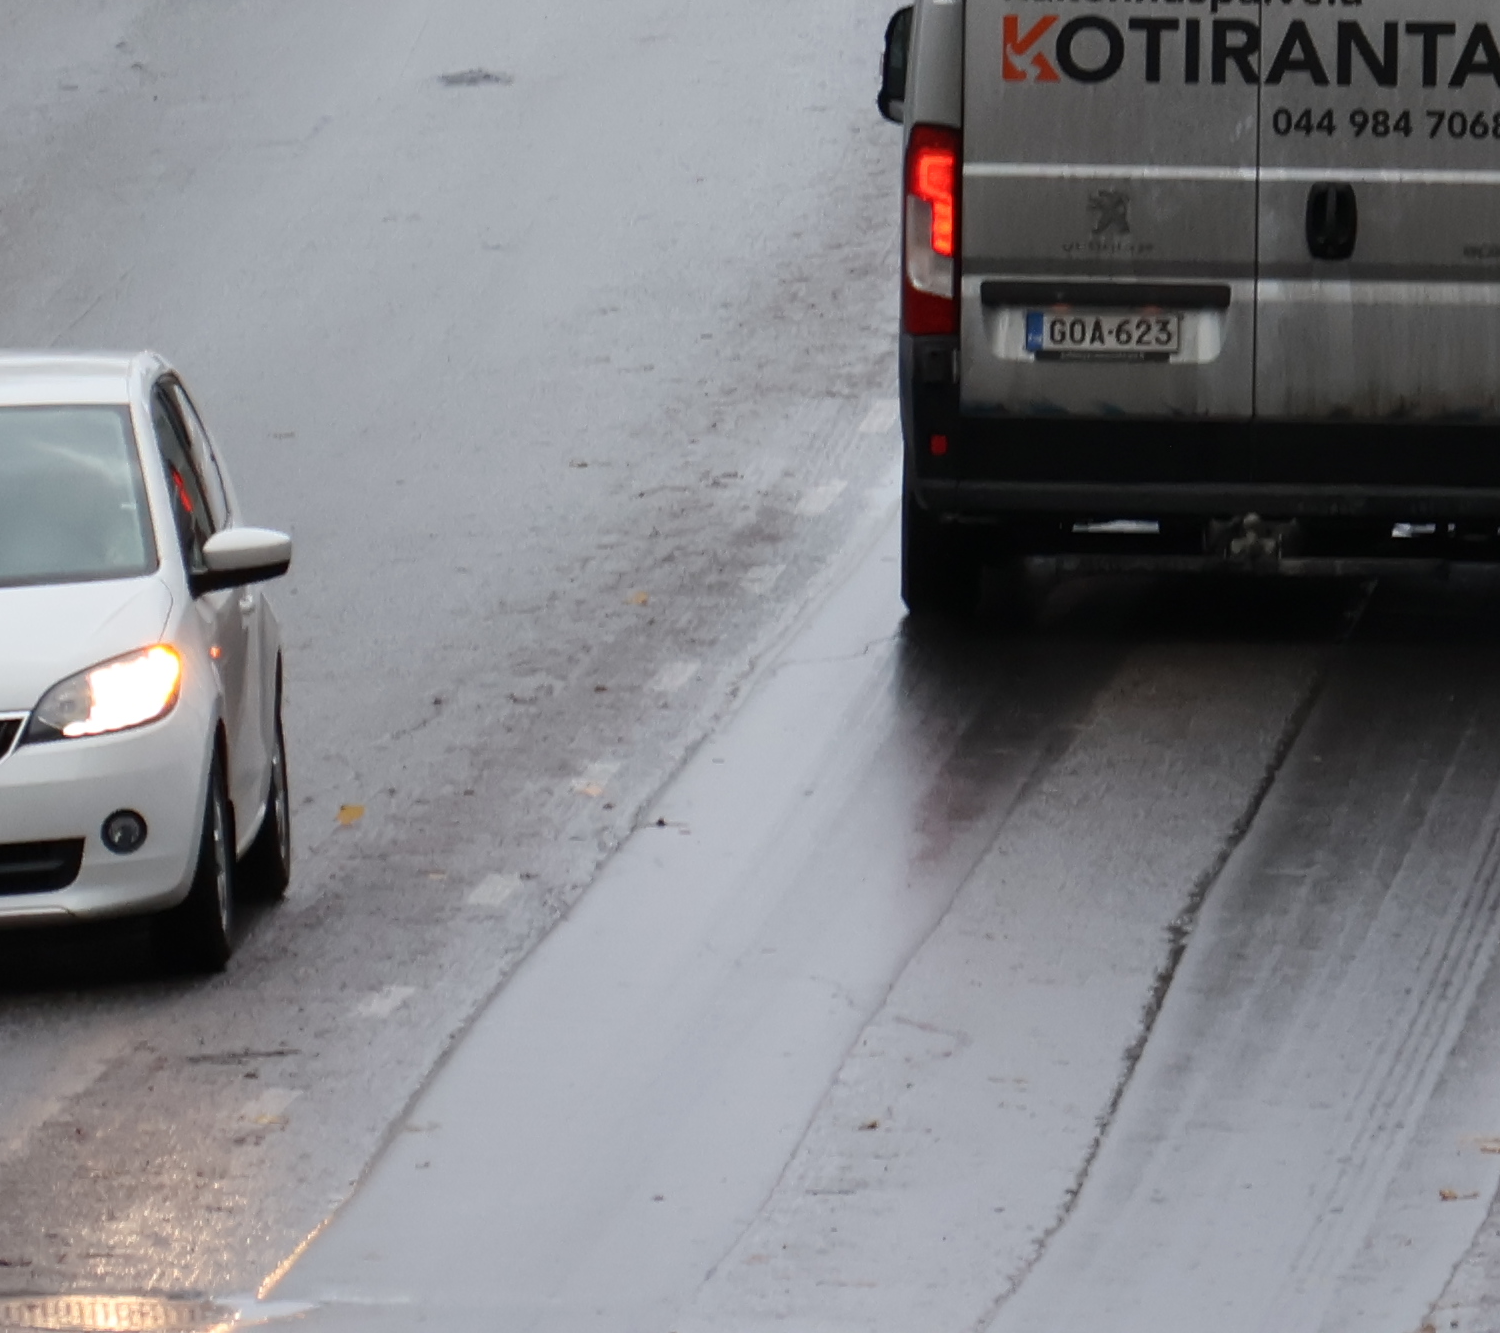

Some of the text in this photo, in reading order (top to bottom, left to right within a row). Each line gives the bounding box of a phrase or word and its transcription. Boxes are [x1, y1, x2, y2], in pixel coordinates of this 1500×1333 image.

[1271, 107, 1338, 137] 044
[1348, 109, 1412, 138] 984
[1049, 318, 1174, 346] GOA-623
